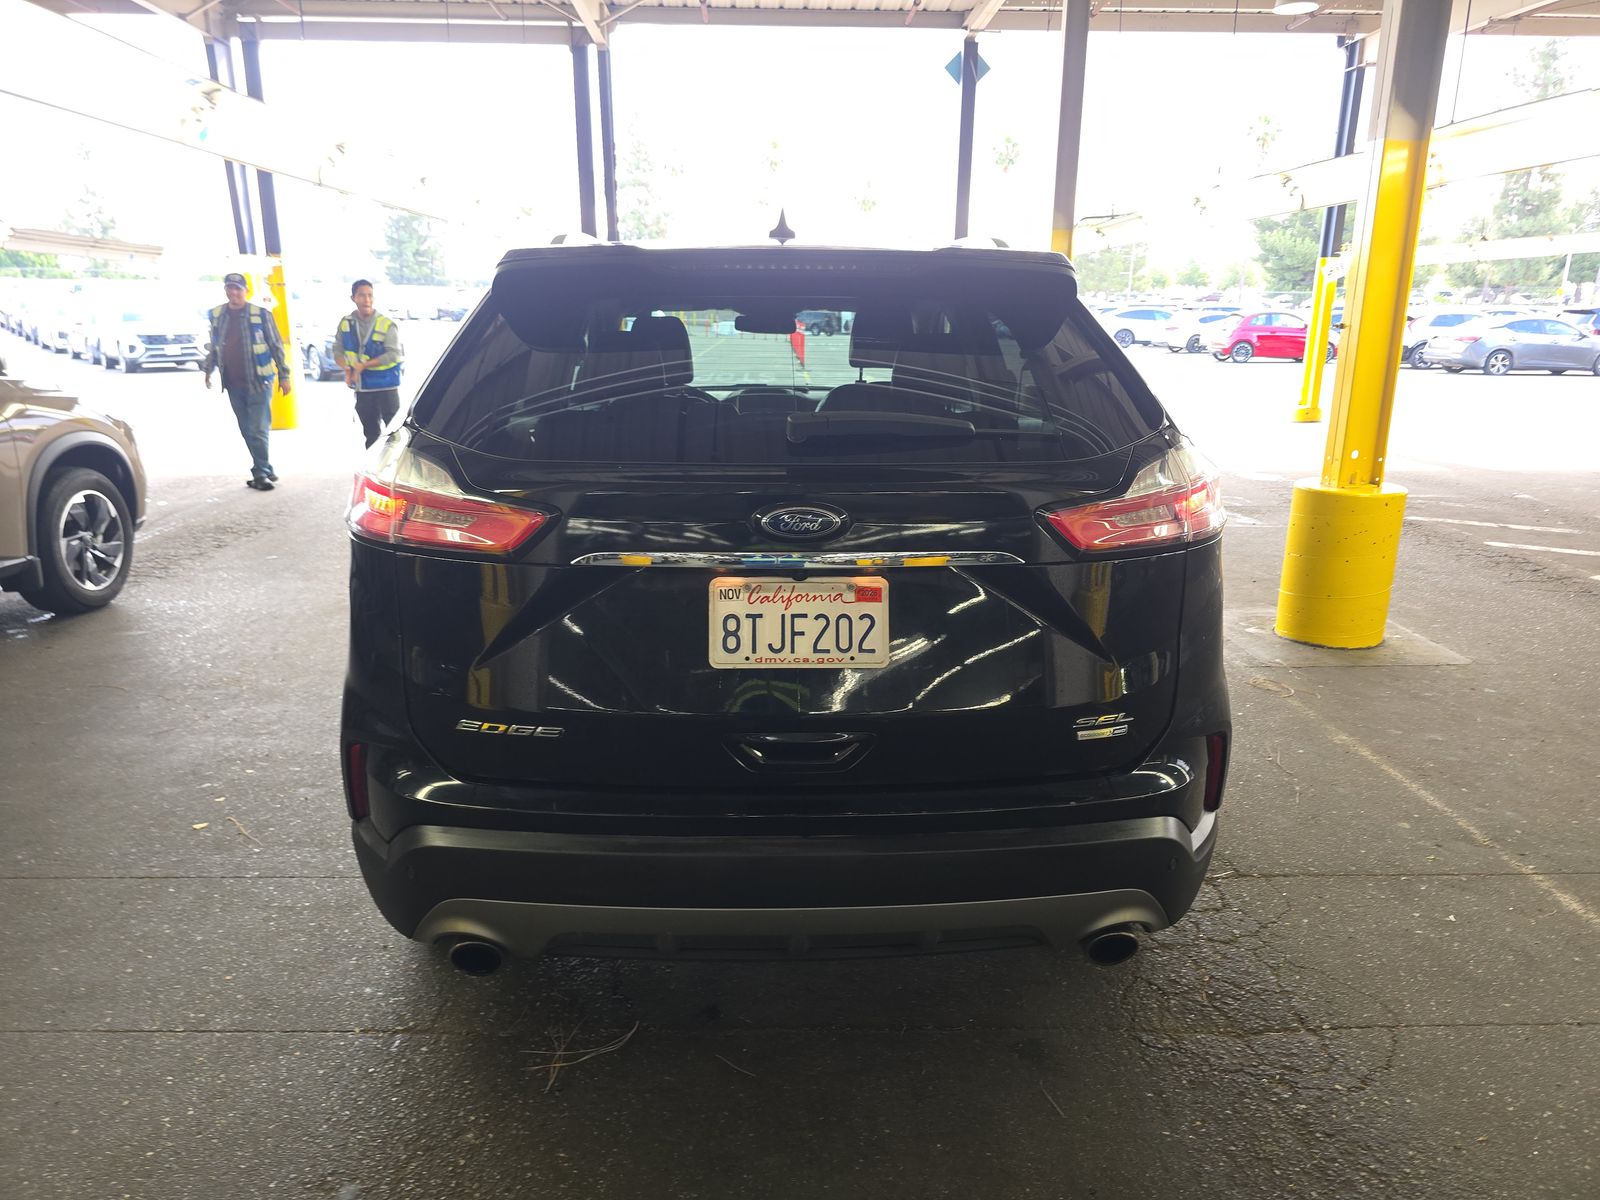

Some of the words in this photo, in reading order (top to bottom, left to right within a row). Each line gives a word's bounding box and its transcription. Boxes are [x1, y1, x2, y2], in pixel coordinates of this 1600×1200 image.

[779, 513, 822, 531] Ford
[719, 588, 742, 600] NOV
[747, 584, 856, 611] California
[722, 613, 877, 655] 8TJF202
[754, 656, 845, 664] dmv.ca.gov
[456, 719, 565, 738] EDGE
[1072, 712, 1135, 728] SEL
